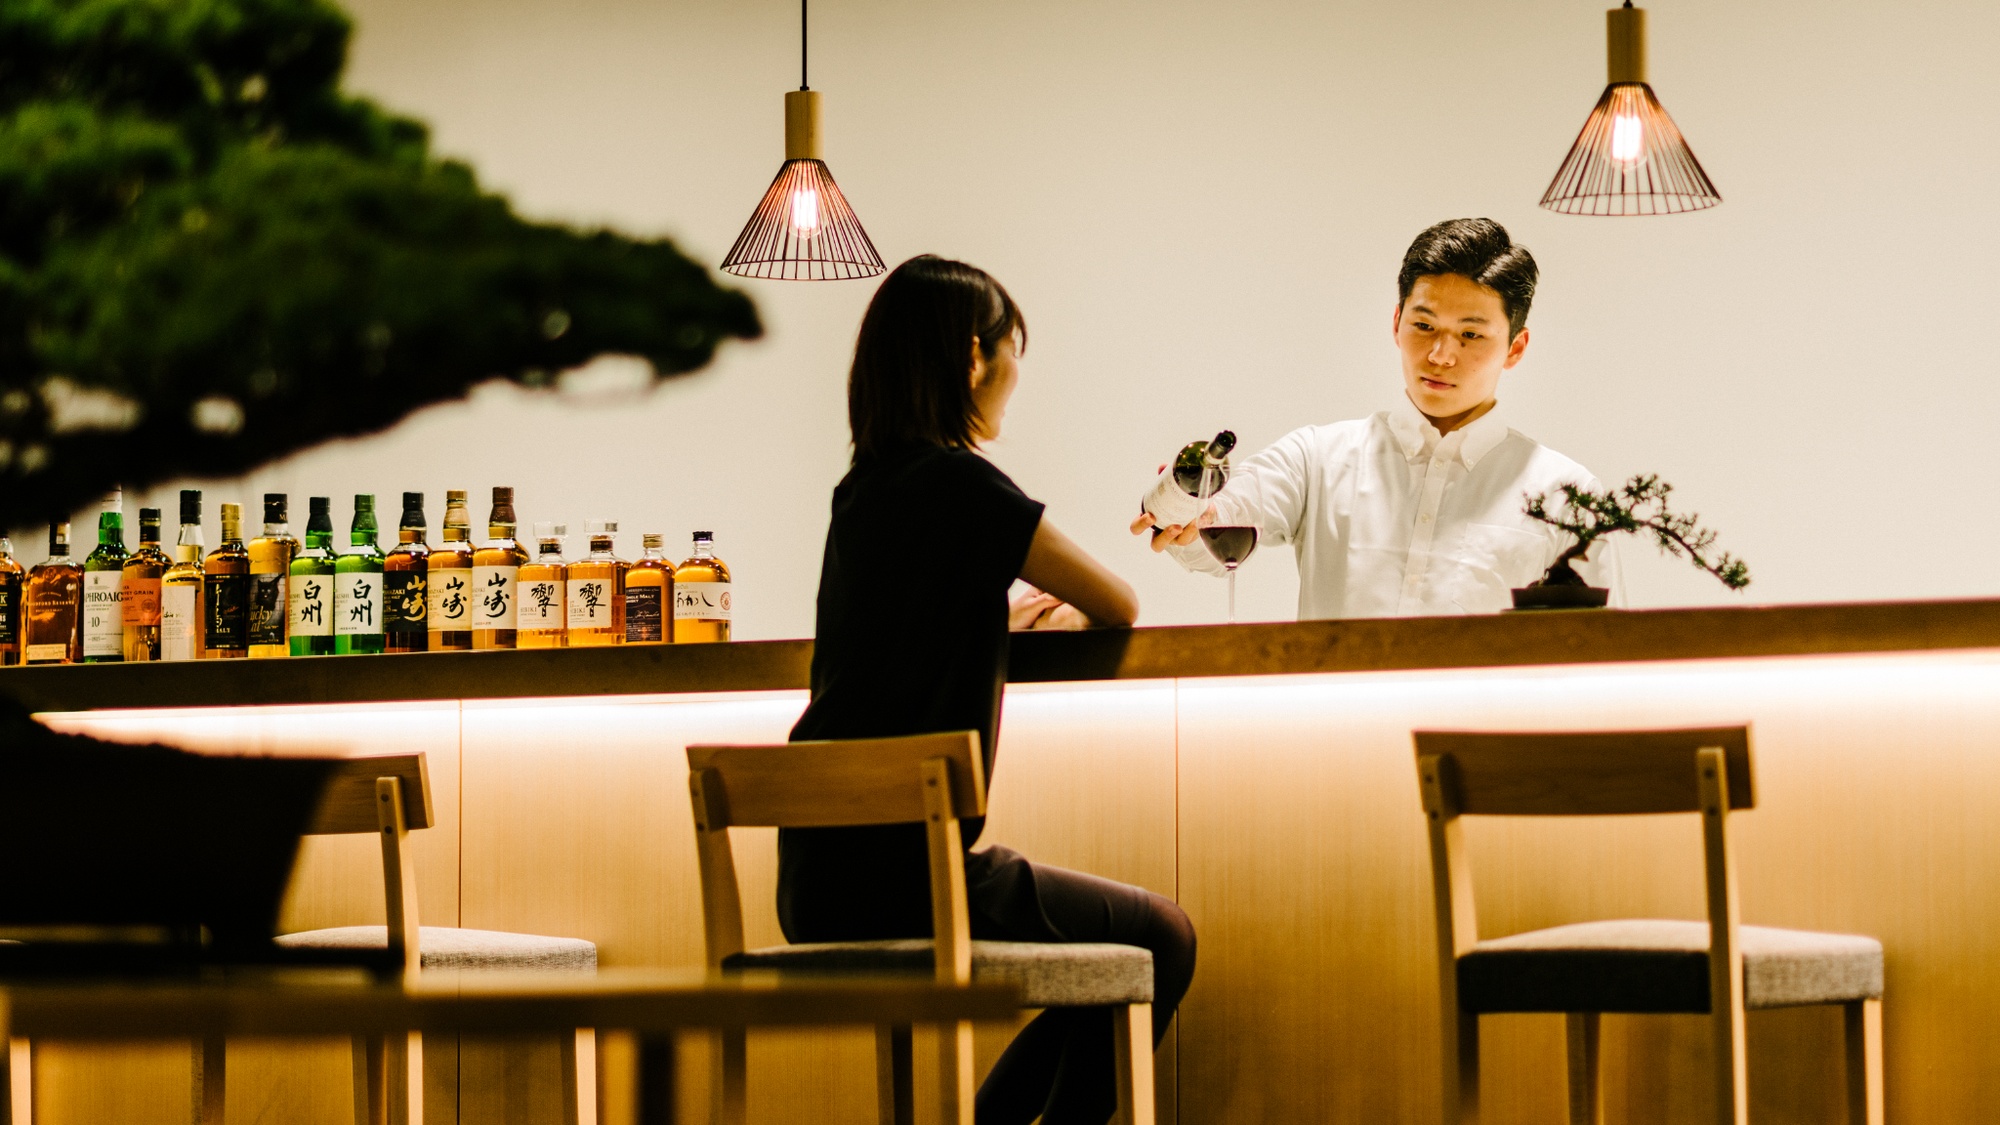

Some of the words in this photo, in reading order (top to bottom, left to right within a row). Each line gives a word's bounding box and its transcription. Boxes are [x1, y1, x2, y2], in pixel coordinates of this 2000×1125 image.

[301, 580, 322, 627] 白州
[350, 578, 372, 627] 白州
[401, 575, 428, 622] 山崎
[442, 576, 468, 619] 山崎
[483, 572, 510, 618] 山崎
[91, 616, 100, 628] 10
